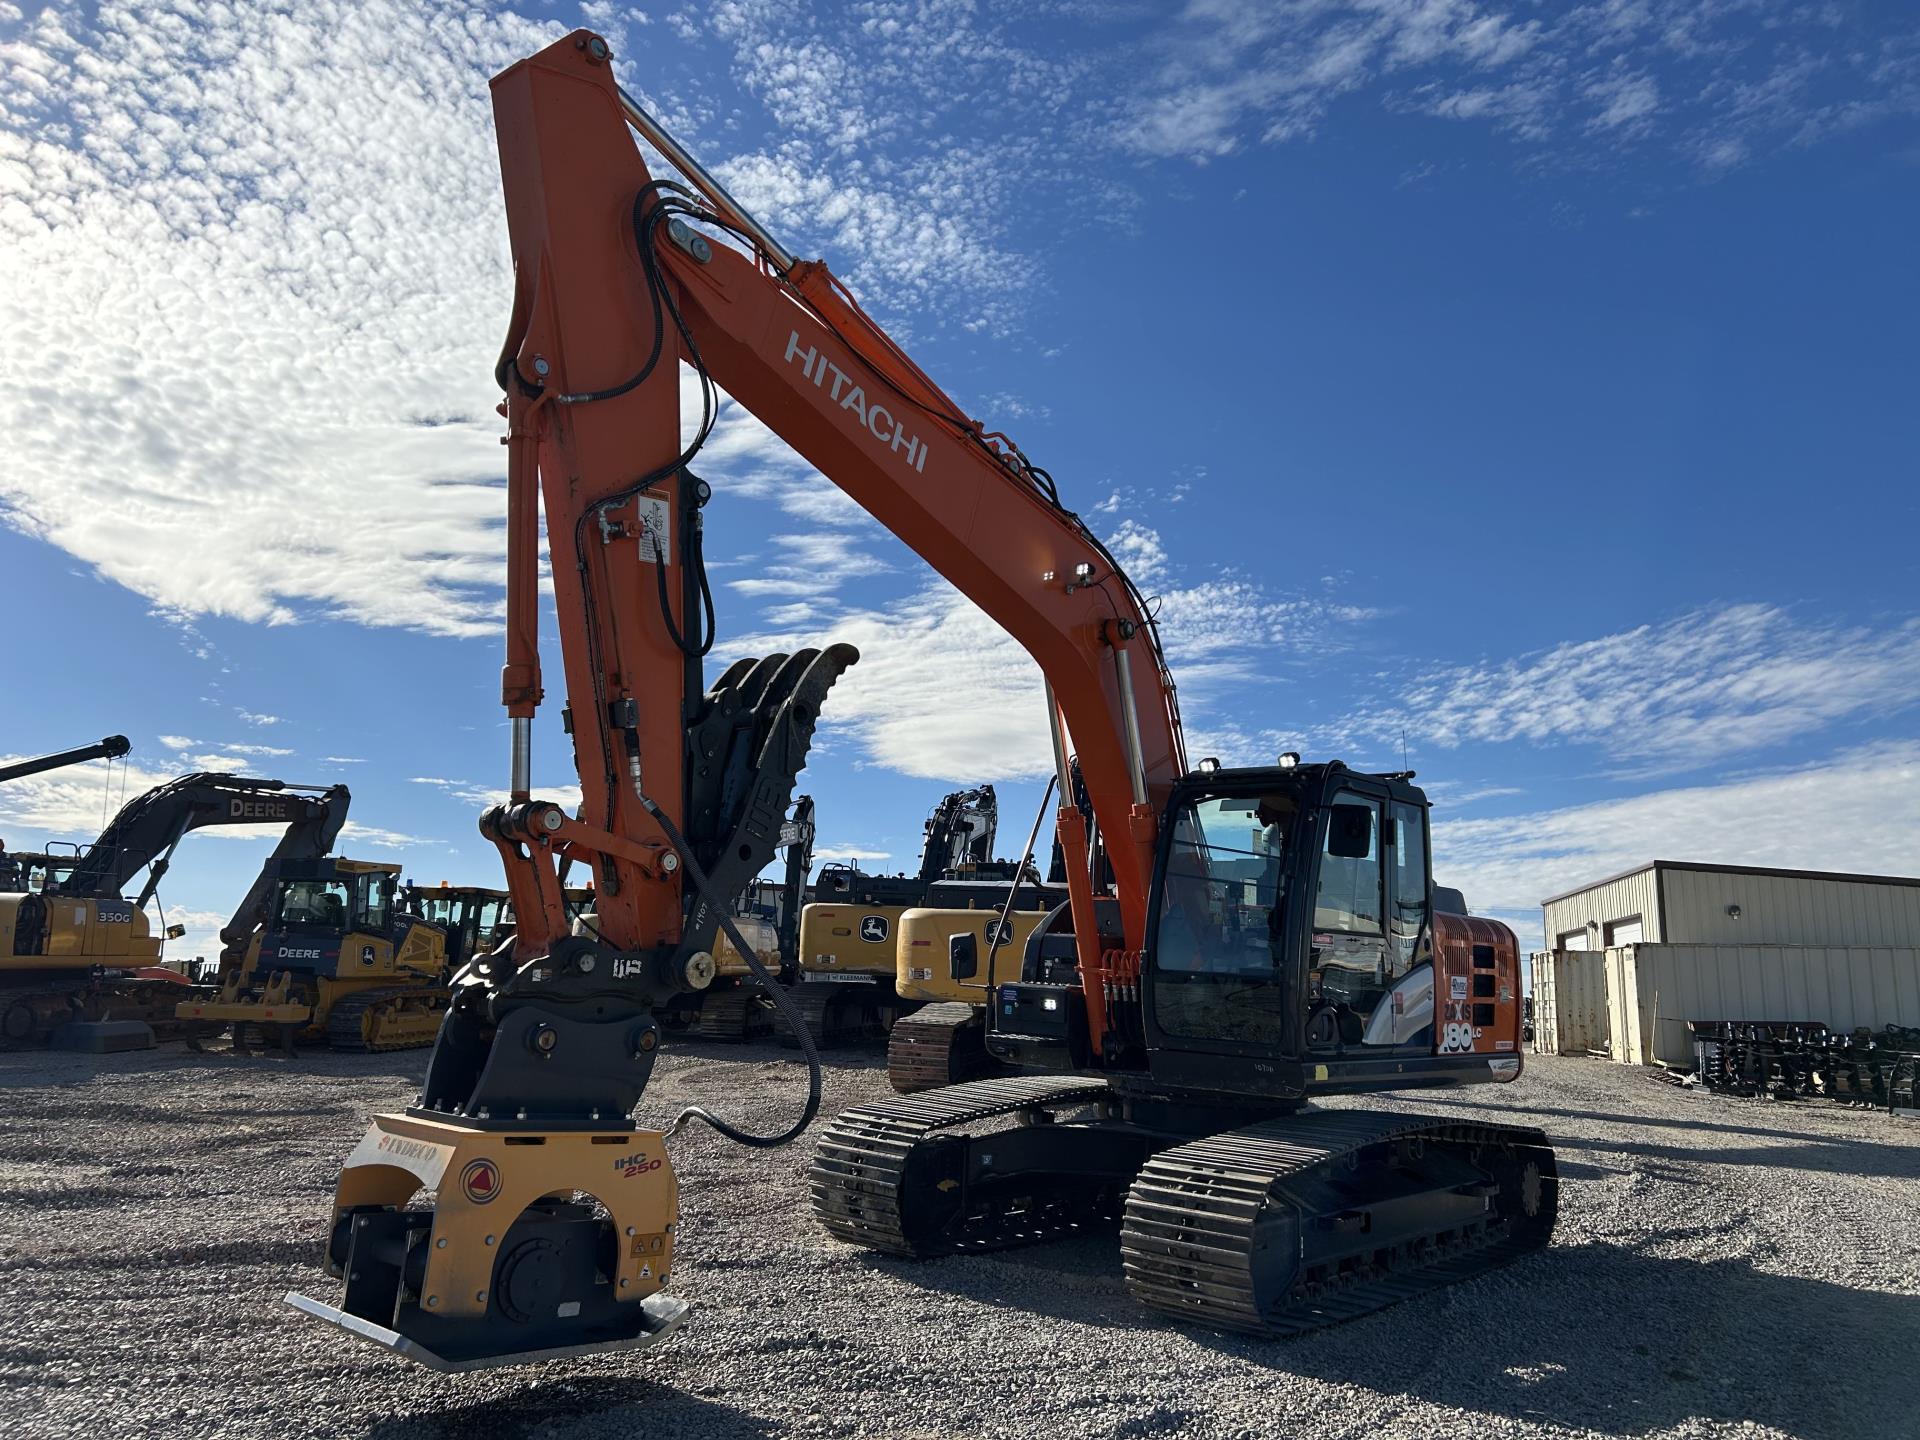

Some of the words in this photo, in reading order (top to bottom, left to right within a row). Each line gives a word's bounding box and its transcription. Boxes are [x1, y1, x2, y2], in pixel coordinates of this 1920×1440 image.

[784, 330, 928, 473] HITACHI
[230, 799, 287, 817] DEERE
[780, 827, 796, 840] ERE
[99, 912, 130, 922] 350G
[278, 947, 320, 959] DEERE
[614, 1152, 647, 1170] IHC
[624, 1159, 662, 1179] 250
